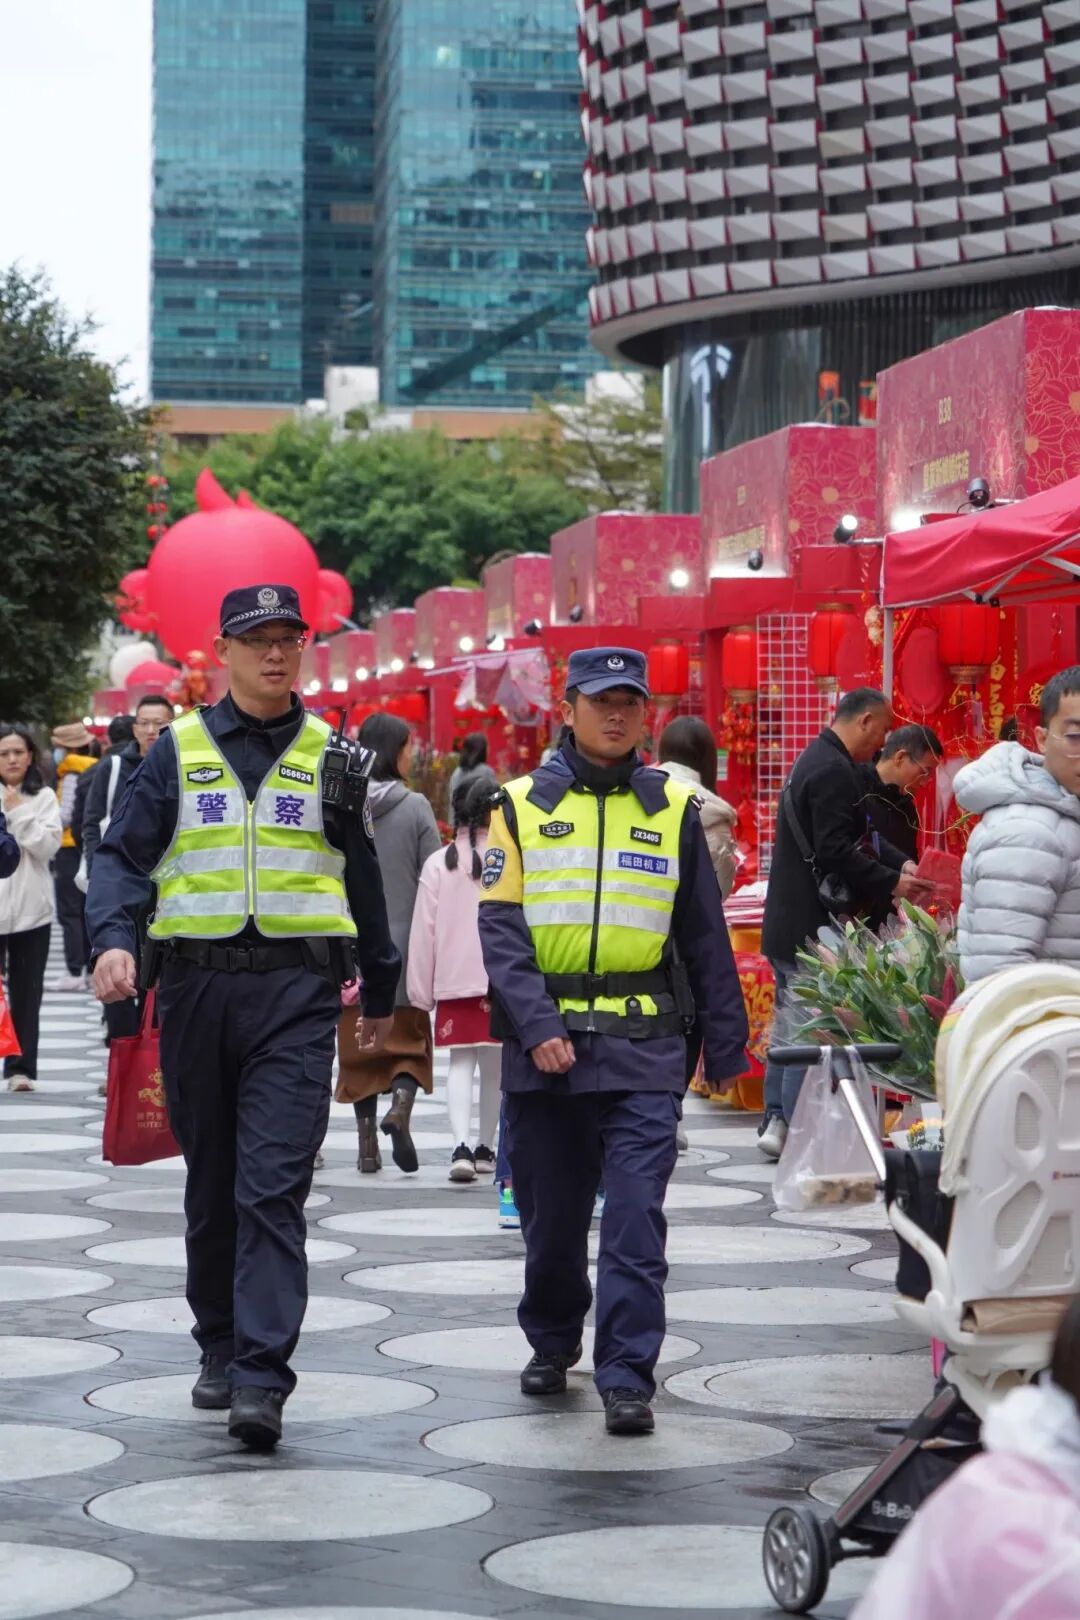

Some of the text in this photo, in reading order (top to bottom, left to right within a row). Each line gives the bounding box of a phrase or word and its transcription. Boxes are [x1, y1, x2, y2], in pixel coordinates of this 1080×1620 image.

[633, 830, 660, 843] JX3405
[620, 854, 666, 873] 福田机训
